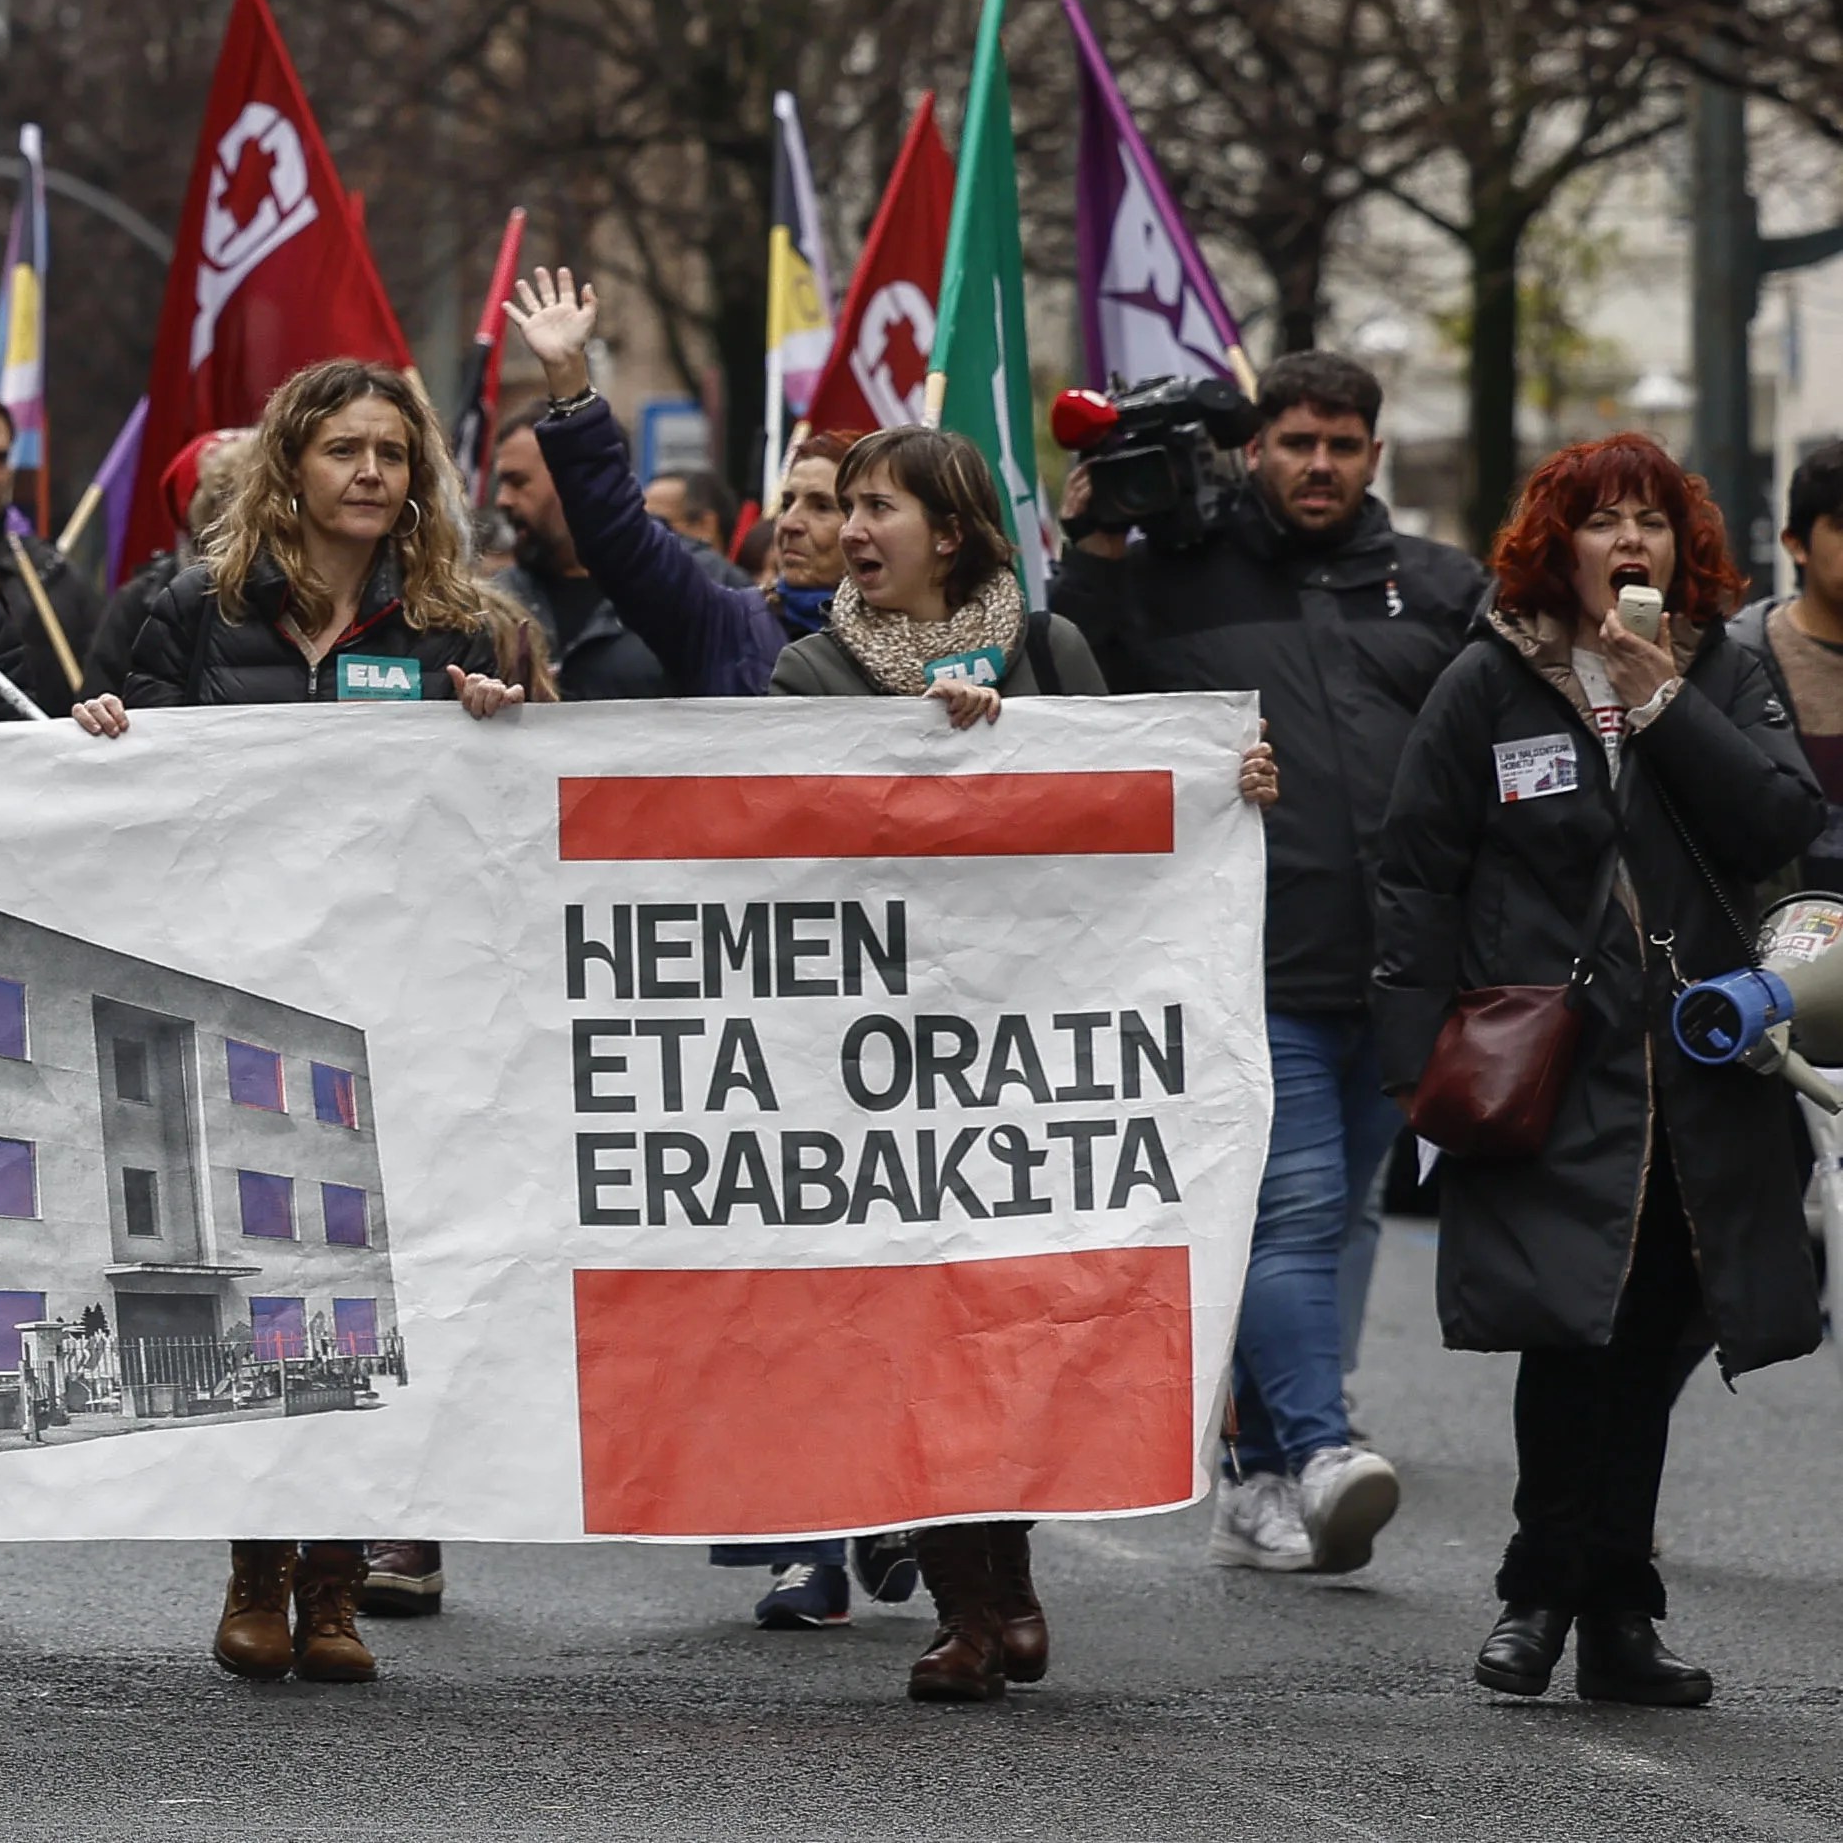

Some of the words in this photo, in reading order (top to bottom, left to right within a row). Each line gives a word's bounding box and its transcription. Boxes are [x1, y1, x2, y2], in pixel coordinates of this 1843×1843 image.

[346, 663, 411, 689] ELA
[565, 900, 908, 1000] HEMEN
[573, 1017, 780, 1113] ETA
[842, 1003, 1185, 1112] ORAIN
[577, 1117, 1181, 1227] ERABAKITA
